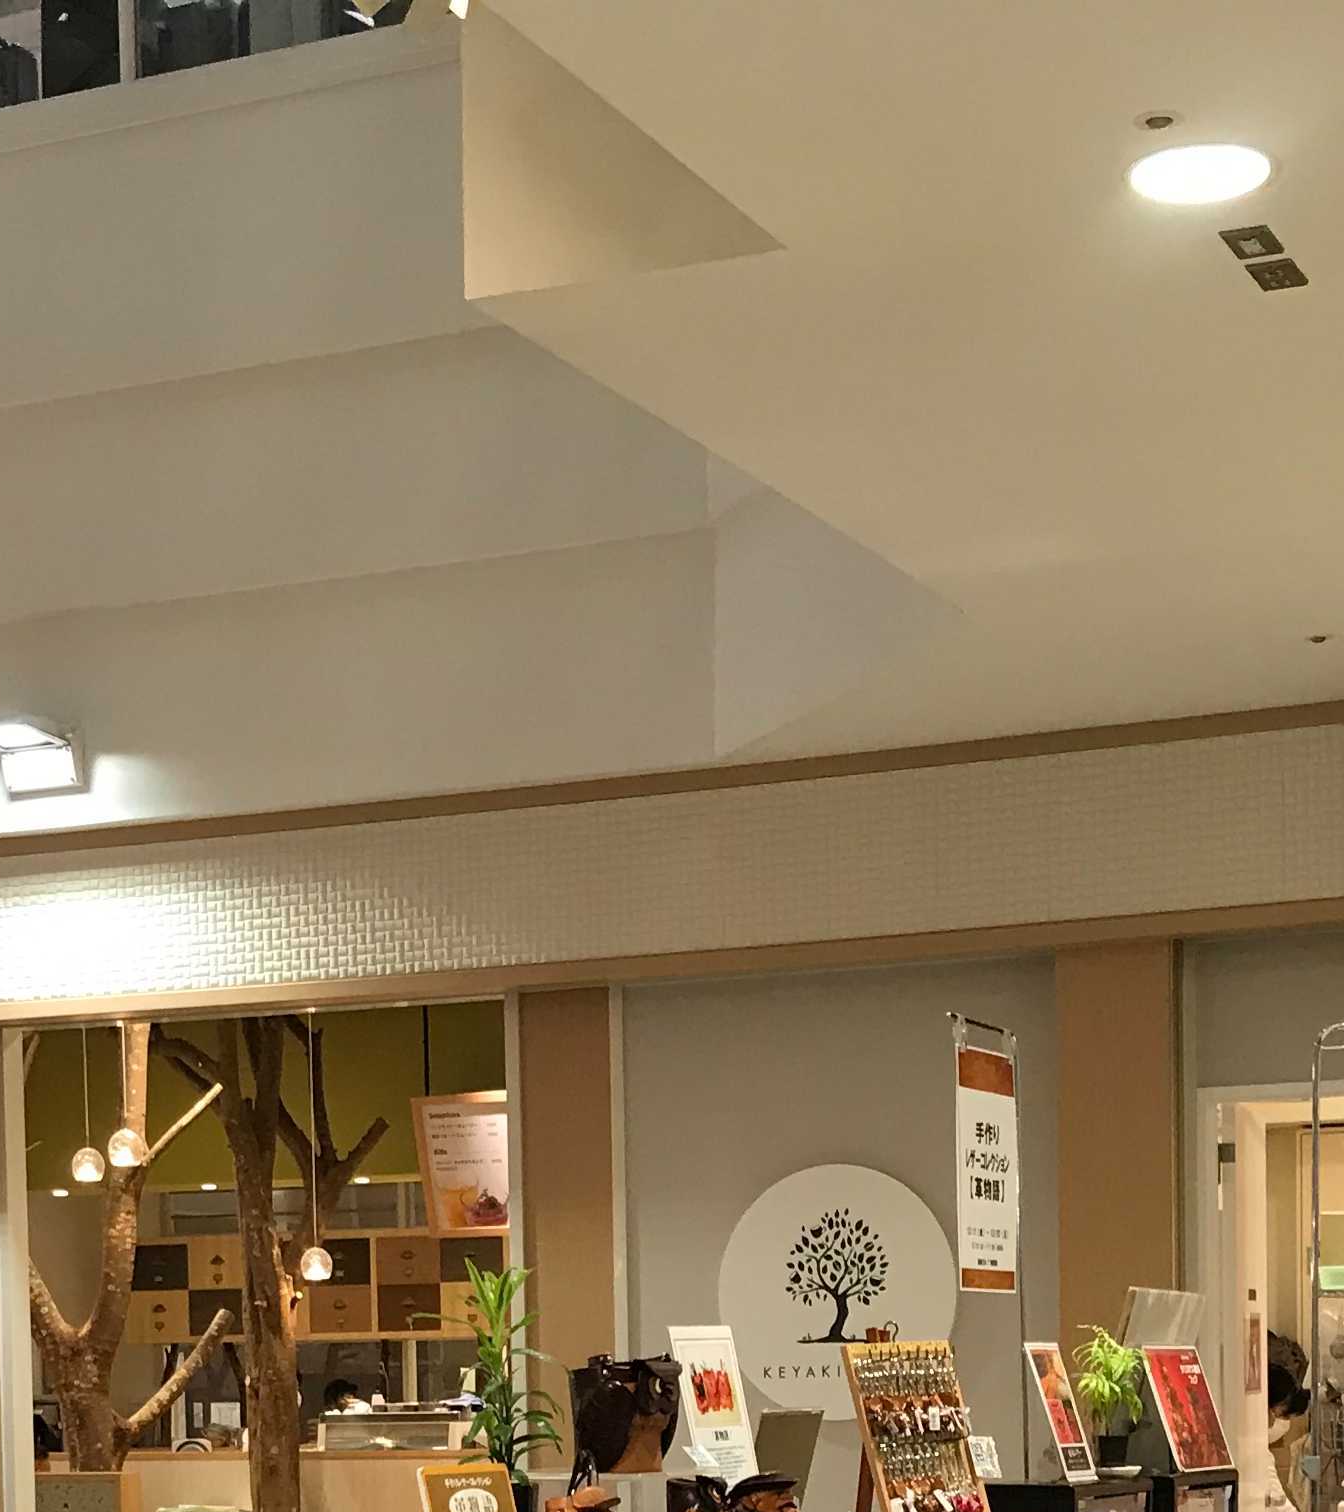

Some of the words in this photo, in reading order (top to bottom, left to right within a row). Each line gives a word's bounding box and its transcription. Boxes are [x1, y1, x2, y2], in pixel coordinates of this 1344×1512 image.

[975, 1122, 1000, 1146] 手作り
[763, 1365, 842, 1379] KEYAKI
